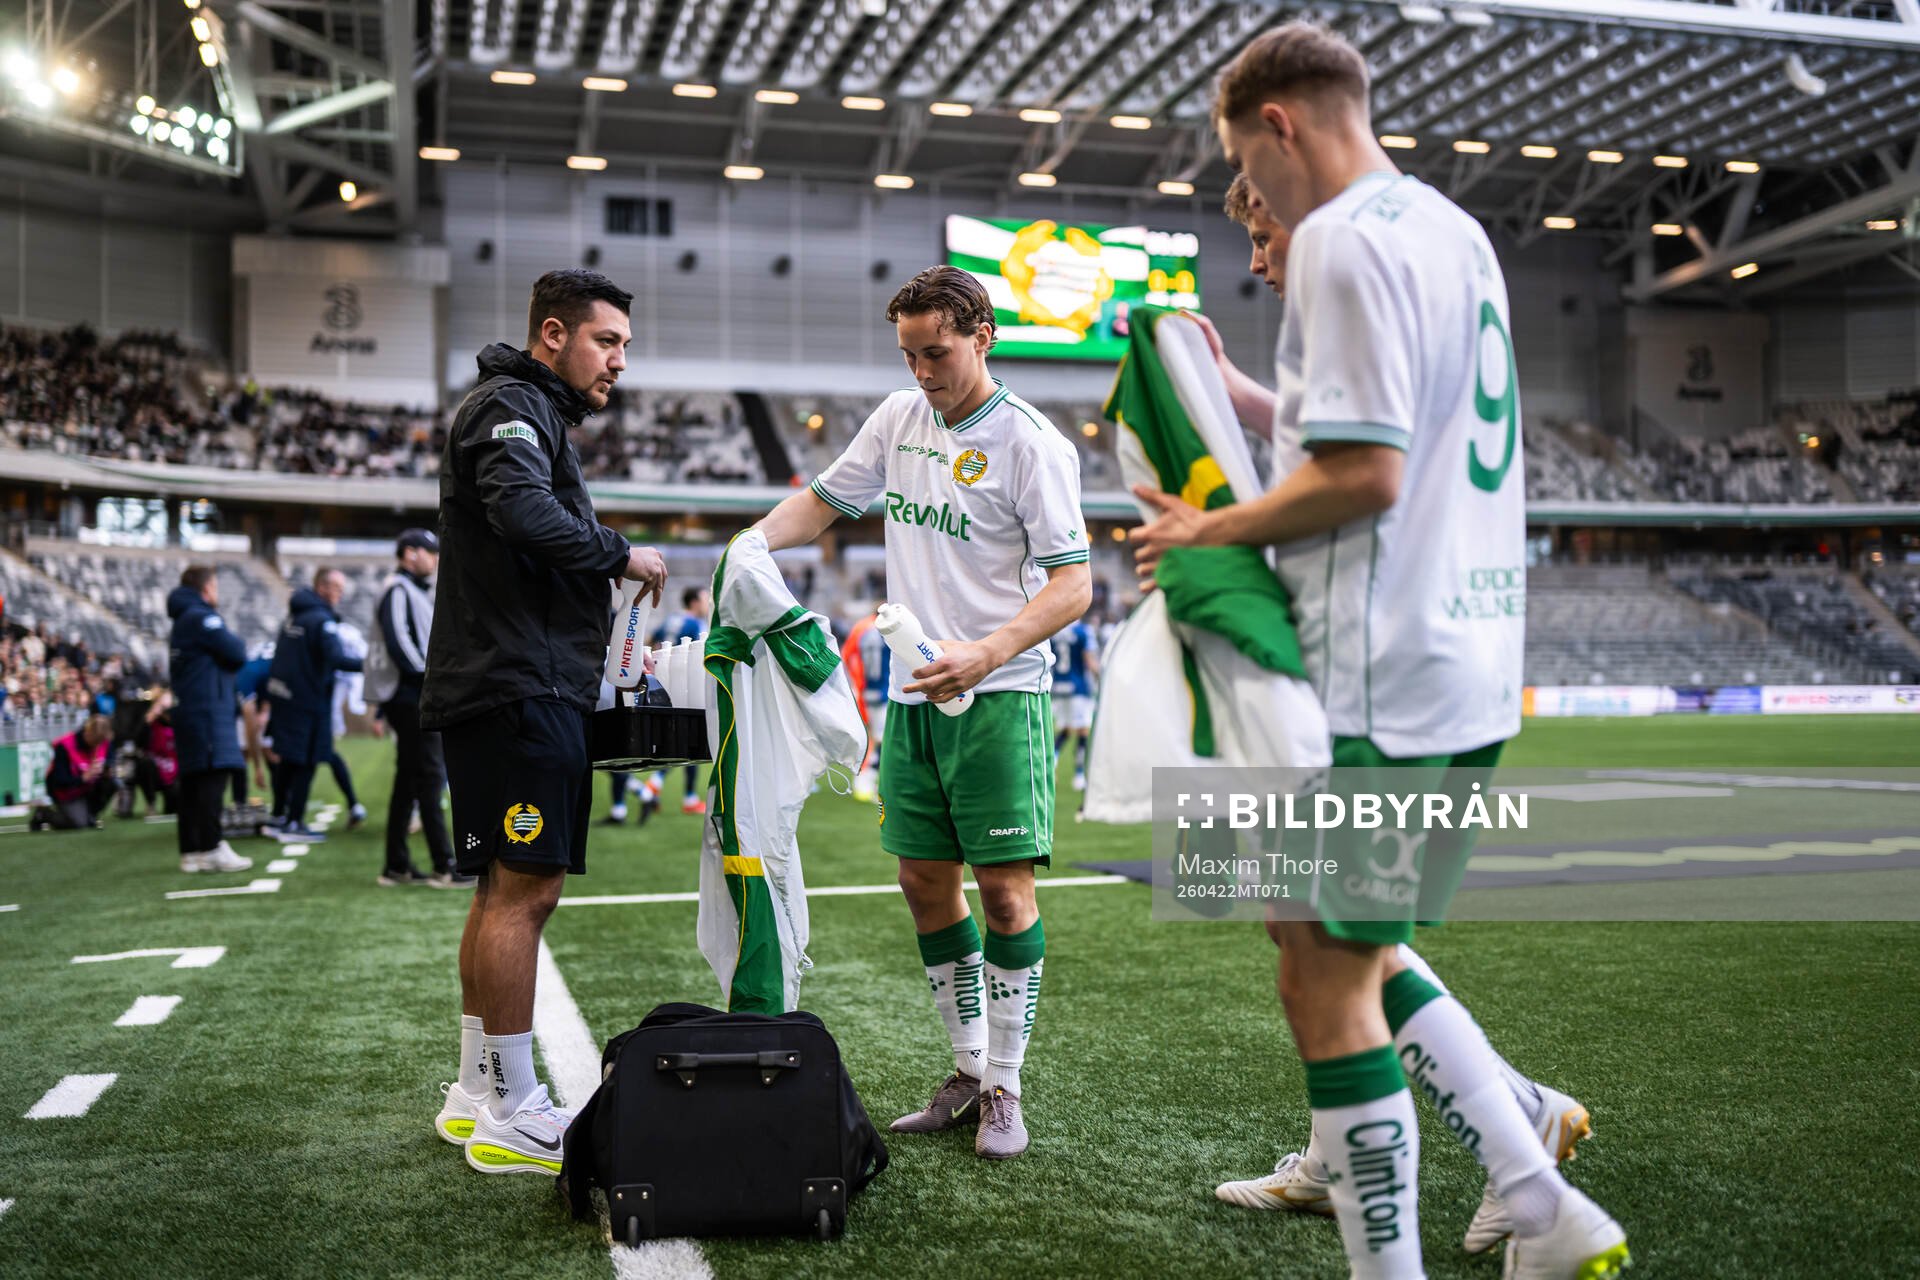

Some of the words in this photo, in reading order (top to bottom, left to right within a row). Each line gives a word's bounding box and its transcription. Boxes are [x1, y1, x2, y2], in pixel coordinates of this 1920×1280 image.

[1469, 300, 1517, 492] 9
[497, 426, 536, 443] UNIBET
[884, 492, 972, 541] Revolut
[621, 606, 640, 668] INTERSPORT
[990, 828, 1020, 836] CRAFT
[491, 1051, 505, 1085] CRAFT
[1345, 1119, 1407, 1244] Clinton
